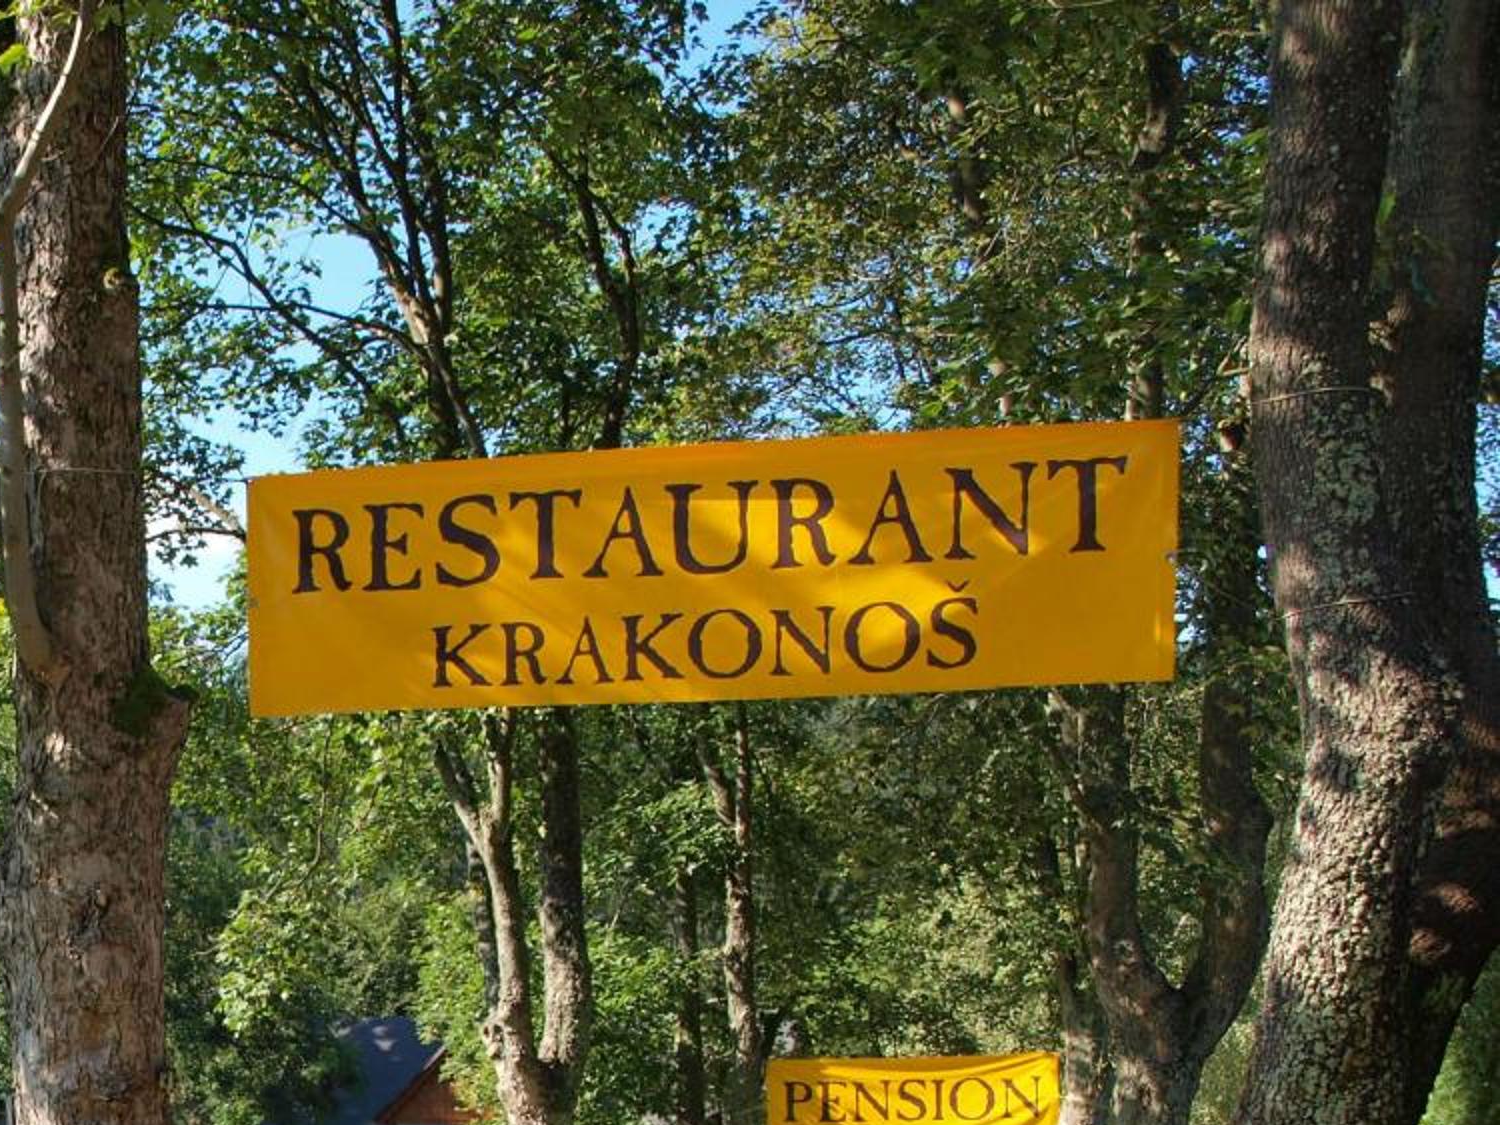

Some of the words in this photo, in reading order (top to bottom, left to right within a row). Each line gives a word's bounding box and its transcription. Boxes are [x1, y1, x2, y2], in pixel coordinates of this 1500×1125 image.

[291, 454, 1129, 595] RESTAURANT
[431, 580, 979, 689] KRAKONOŠ
[783, 1075, 1042, 1123] PENSION
